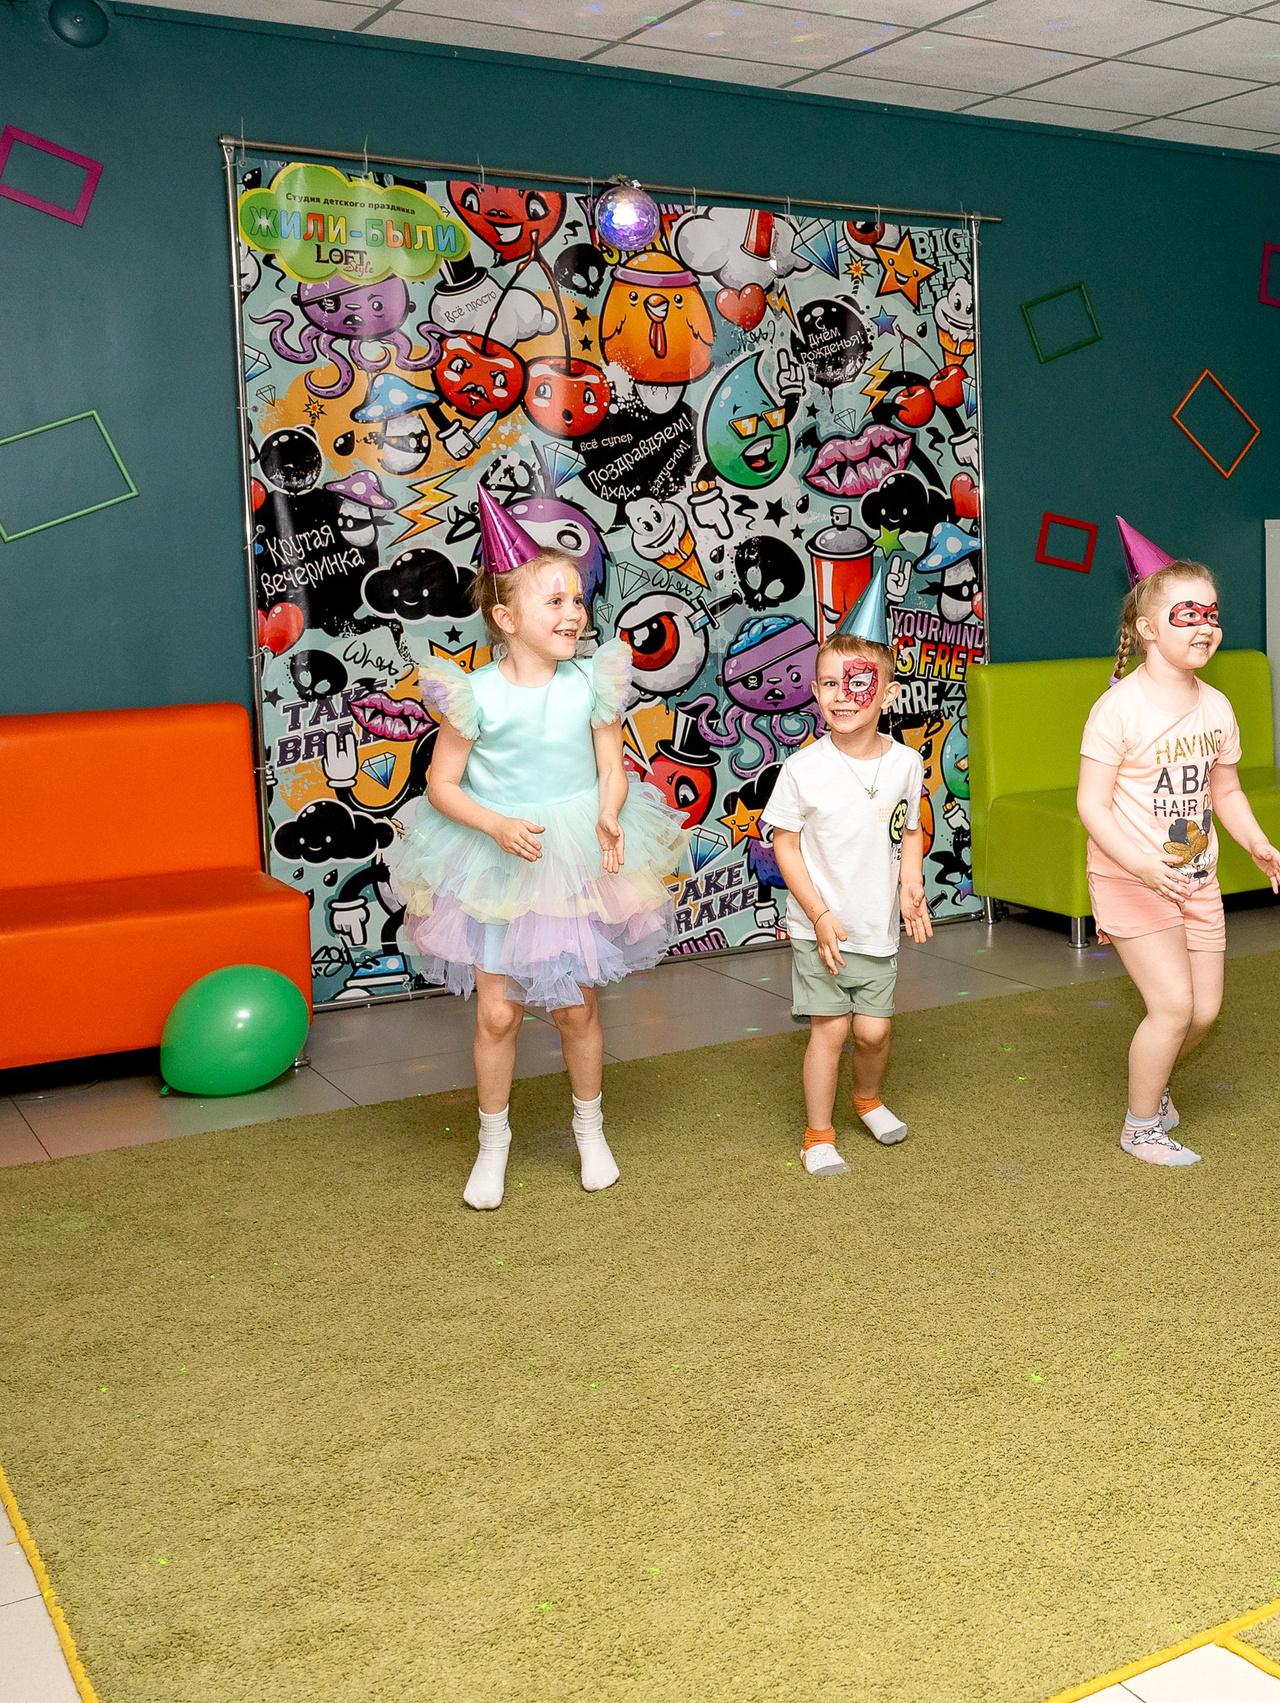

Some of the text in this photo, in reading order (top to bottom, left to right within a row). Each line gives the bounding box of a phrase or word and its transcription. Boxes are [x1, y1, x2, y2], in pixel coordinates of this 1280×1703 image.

[286, 192, 416, 215] Студия детского праздника
[250, 206, 456, 252] ЖИЛИ-БЫЛИ
[912, 228, 971, 260] BIG
[315, 244, 367, 264] LOFT
[343, 261, 374, 277] Style
[466, 291, 497, 312] просто
[601, 433, 633, 448] супер
[266, 525, 335, 567] Крутая
[894, 610, 984, 649] YOUR MIND
[919, 642, 982, 680] FREE
[1156, 729, 1222, 764] HAVING
[1153, 758, 1218, 794] A BA
[1153, 799, 1198, 817] HAIR
[668, 861, 744, 907] AKE
[675, 883, 759, 934] RAKE
